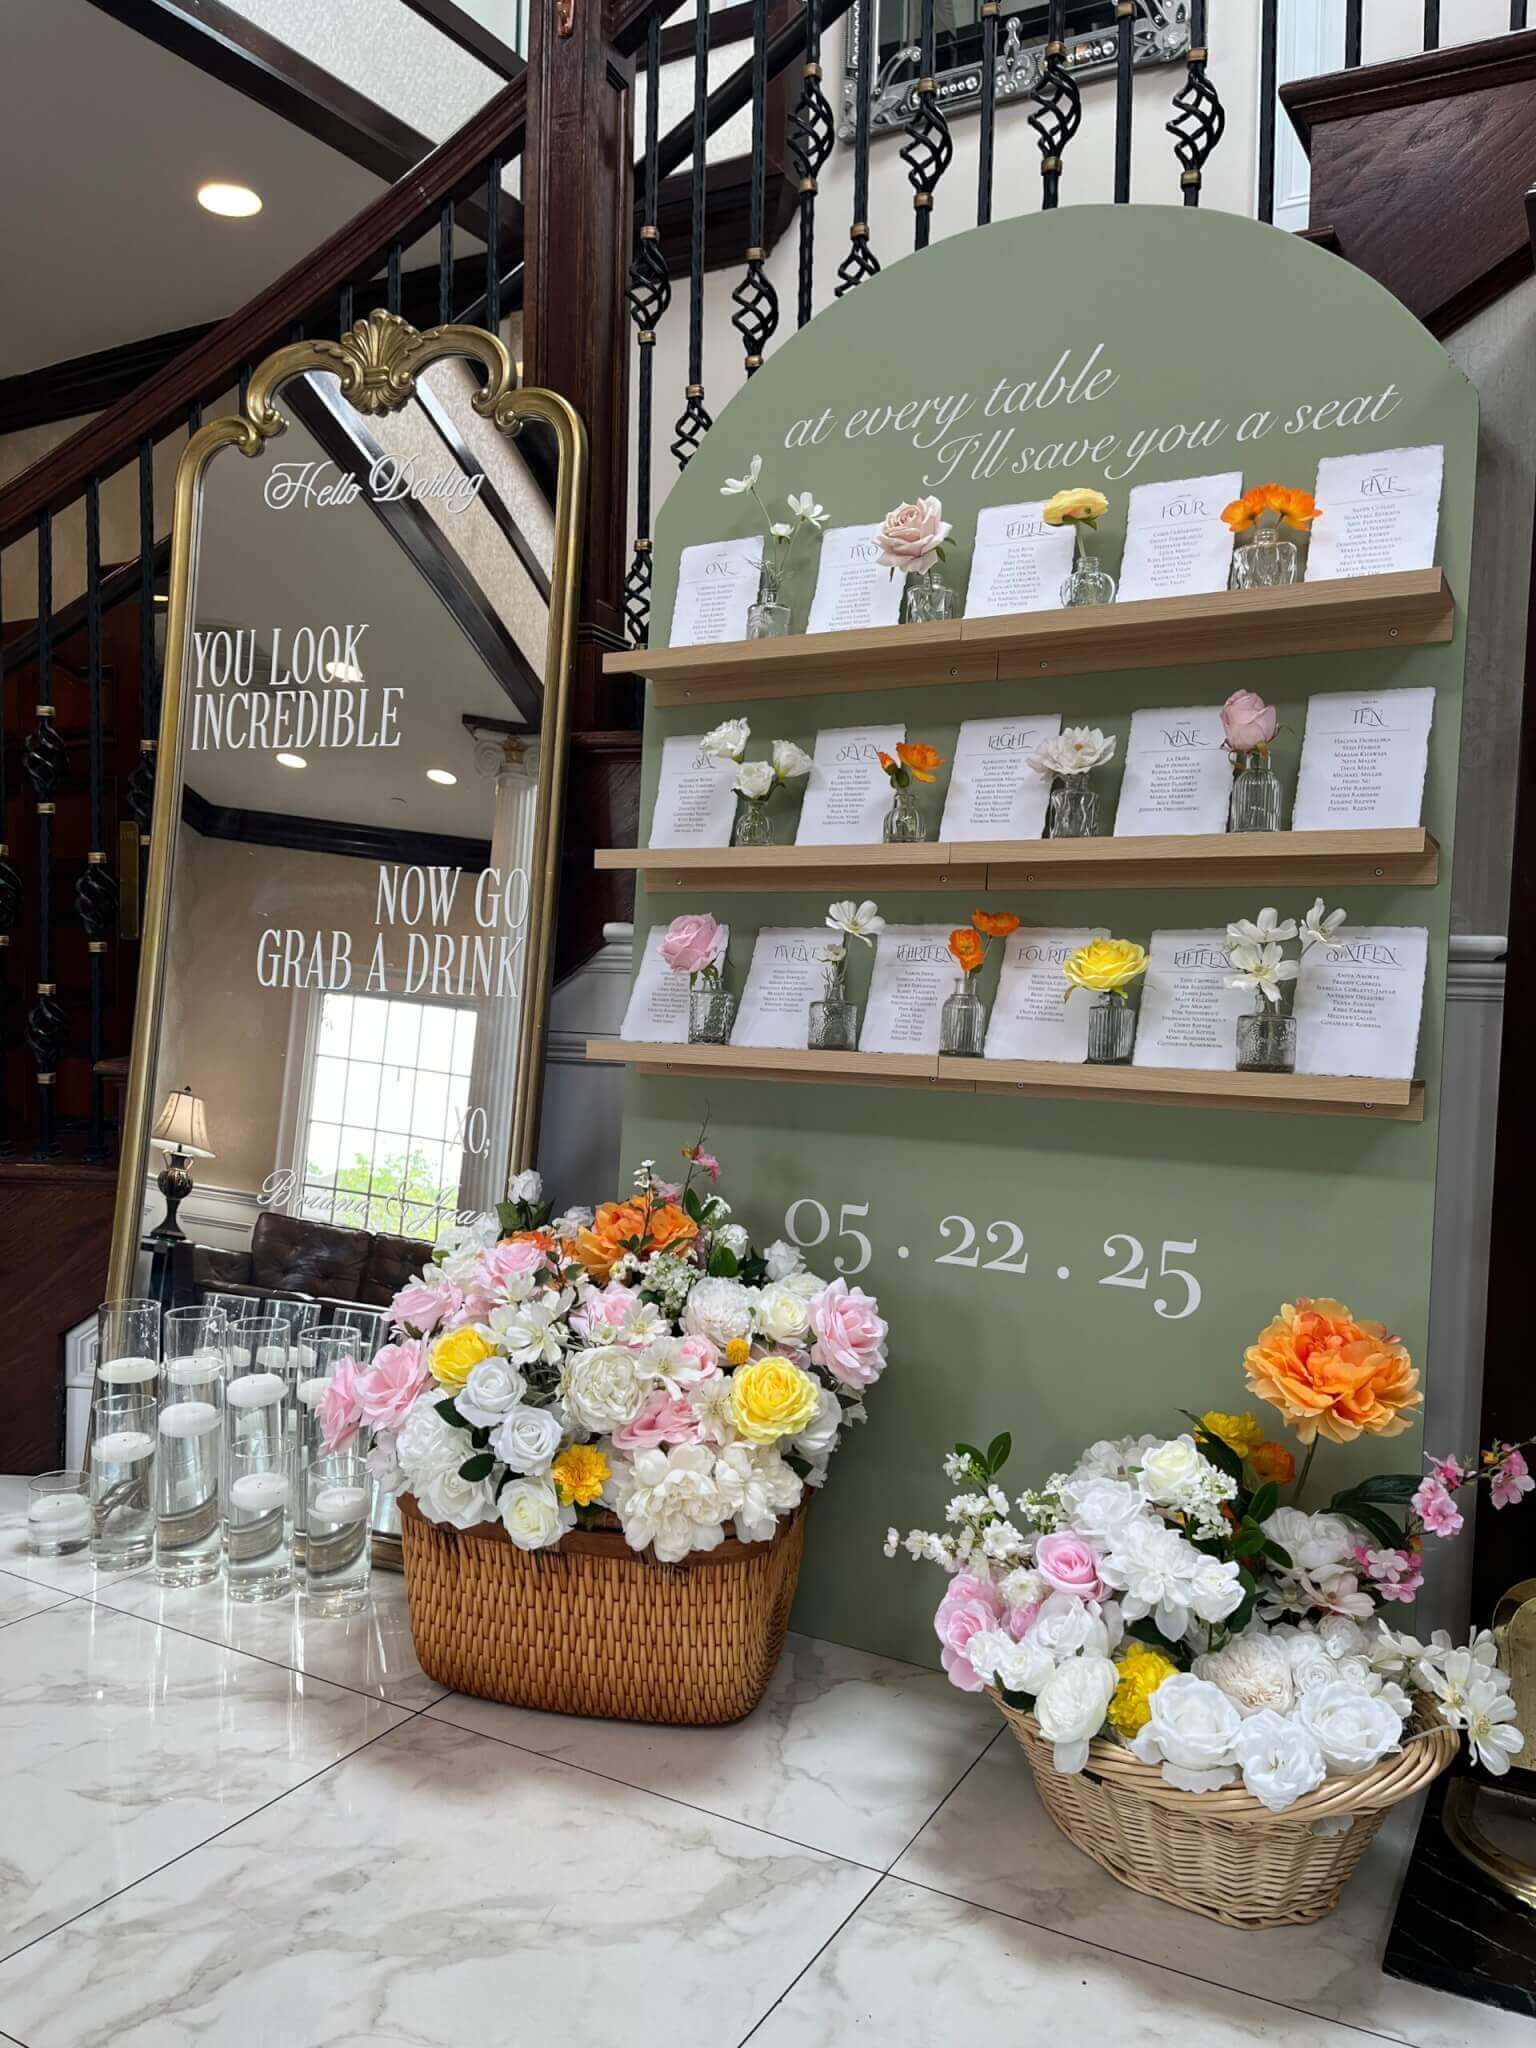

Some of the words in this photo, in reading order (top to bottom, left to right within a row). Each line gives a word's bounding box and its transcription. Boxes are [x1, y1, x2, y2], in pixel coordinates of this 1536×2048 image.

[784, 408, 836, 449] at
[845, 393, 974, 449] every
[985, 343, 1120, 417] table
[922, 427, 1013, 487] I'll
[1012, 434, 1121, 474] save
[1104, 417, 1229, 481] you
[1236, 410, 1279, 442] a
[1284, 384, 1403, 435] seat
[263, 460, 364, 511] Hello
[368, 453, 485, 515] Darling
[1161, 498, 1211, 520] FOUR
[704, 560, 738, 577] ONE
[848, 544, 879, 561] TWO
[192, 629, 256, 689] YOU
[269, 624, 370, 687] LOOK
[190, 687, 405, 752] INCREDIBLE
[1351, 707, 1390, 727] TEN
[988, 728, 1037, 751] EIGHT
[1160, 729, 1211, 748] NINE
[374, 865, 463, 928] NOW
[474, 866, 531, 929] GO
[256, 928, 353, 990] GRAB
[366, 931, 389, 992] A
[404, 933, 526, 998] DRINK
[774, 942, 834, 962] TWELVE
[1018, 945, 1072, 965] FOURTE
[784, 1198, 872, 1274] 05
[934, 1215, 1029, 1274] 22
[1098, 1233, 1203, 1319] 25
